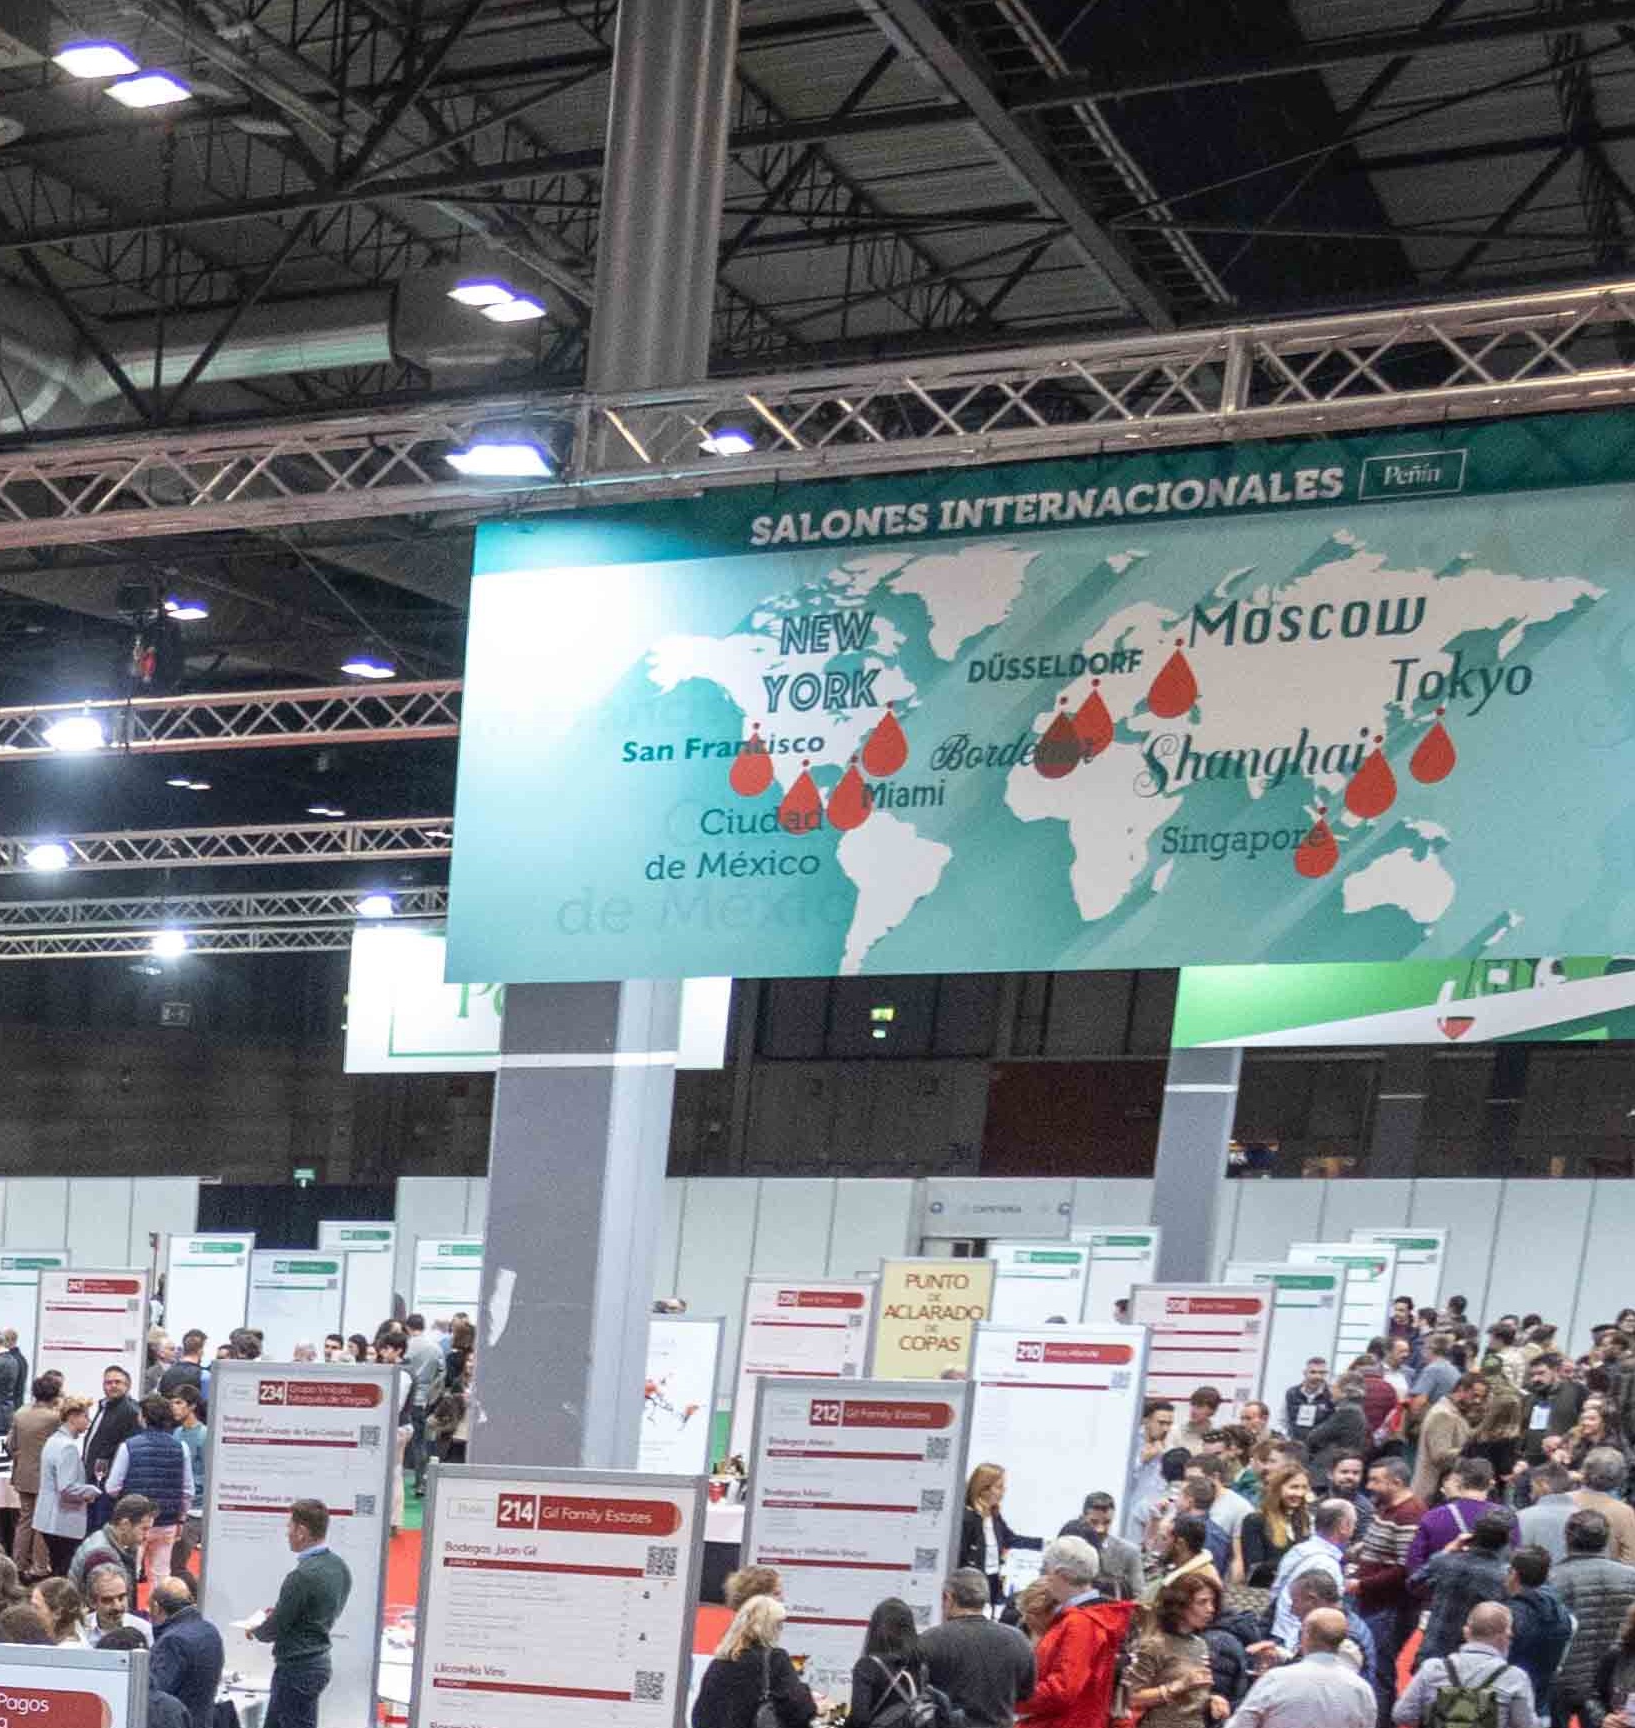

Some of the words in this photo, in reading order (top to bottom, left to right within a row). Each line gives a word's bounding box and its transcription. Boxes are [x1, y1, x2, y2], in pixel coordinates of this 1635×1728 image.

[1384, 461, 1442, 487] Peñín
[751, 503, 929, 546] SALONES
[939, 467, 1344, 530] INTERNACIONALES
[780, 610, 875, 655] NEW
[1189, 596, 1428, 648] Moscow
[968, 648, 1142, 683] DÜSSELDORF
[762, 668, 882, 713] YORK
[1391, 658, 1533, 716] Tokyo
[622, 739, 673, 763] San
[685, 733, 826, 760] Francisco
[1133, 727, 1370, 797] Shanghai
[862, 780, 945, 807] Miami
[700, 807, 823, 836] Ciudad
[1162, 824, 1326, 860] Singapore
[646, 855, 686, 880] de
[696, 851, 821, 879] México
[906, 1274, 969, 1290] PUNTO
[884, 1304, 985, 1321] ACLARADO
[898, 1335, 962, 1353] COPAS
[260, 1385, 283, 1400] 234
[812, 1404, 840, 1421] 212
[498, 1500, 533, 1522] 214
[542, 1504, 560, 1519] Gil
[562, 1507, 602, 1524] Family
[605, 1510, 652, 1525] Estates
